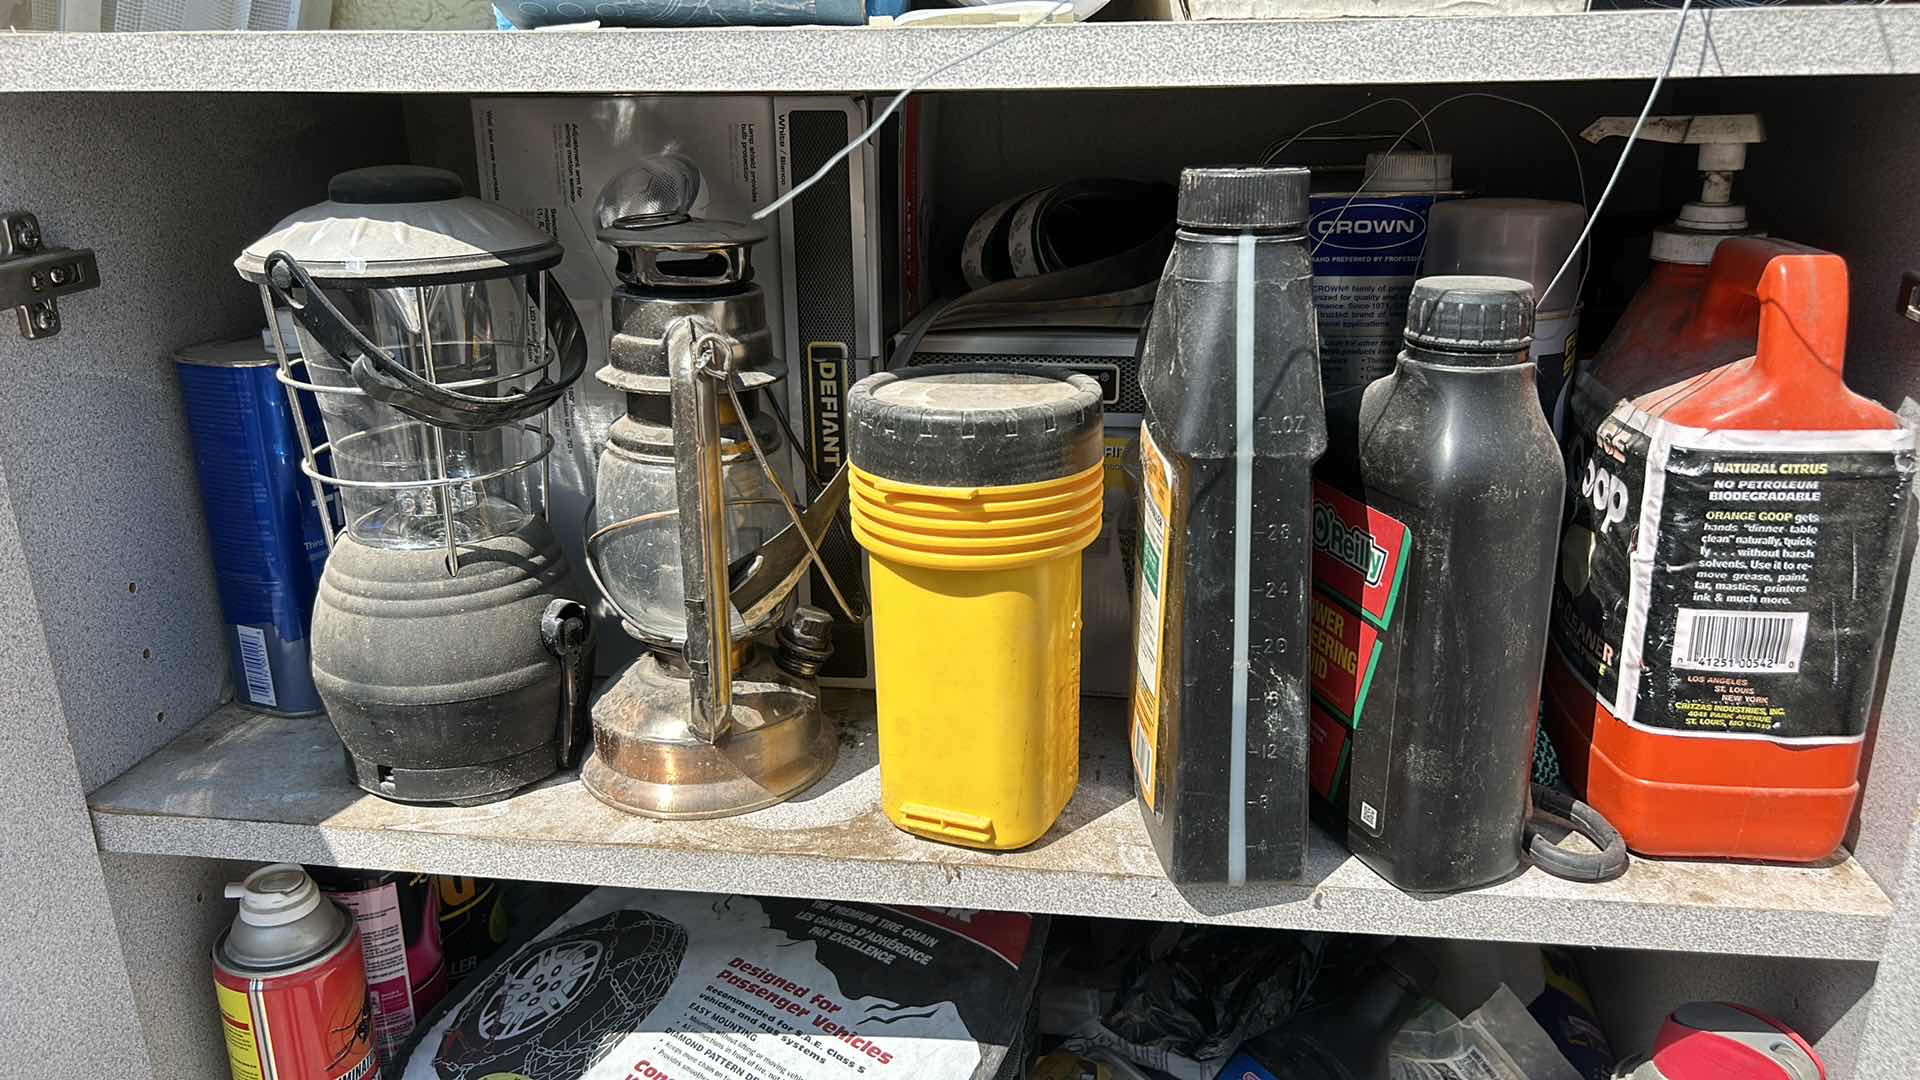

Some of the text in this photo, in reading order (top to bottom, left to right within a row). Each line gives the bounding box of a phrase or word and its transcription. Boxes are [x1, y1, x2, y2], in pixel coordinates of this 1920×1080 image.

[778, 114, 786, 147] White
[1318, 219, 1414, 234] CROWN
[819, 361, 841, 466] DEFIANT
[1712, 462, 1829, 474] NATURAL CITRUS
[1713, 480, 1820, 490] NO PETROLEUM
[1708, 491, 1821, 501] BIODEGRADABLE
[1705, 511, 1820, 524] ORANGE GOOP gets
[1703, 522, 1739, 532] hands
[1789, 524, 1819, 534] table
[1735, 535, 1783, 547] naturally,
[1783, 536, 1817, 547] quick-
[1738, 547, 1780, 558] without
[1782, 548, 1815, 559] harsh
[1698, 559, 1813, 571] solvents. Use it to re-
[1732, 573, 1773, 582] grease,
[1265, 580, 1289, 600] 24
[1693, 581, 1807, 594] tar, mastics, printers
[1692, 592, 1792, 605] ink & much more.
[1263, 637, 1288, 654] 20
[1698, 658, 1733, 668] 41251
[1739, 659, 1773, 668] 00542
[1687, 675, 1748, 686] LOS ANGELES
[1728, 686, 1755, 695] LOUIS
[1721, 694, 1769, 704] NEW YORK
[1674, 702, 1713, 711] CRITZAS
[1713, 703, 1767, 715] INDUSTRIES,
[1709, 711, 1735, 720] PARK
[1735, 713, 1773, 724] AVENUE
[1261, 743, 1279, 759] 12
[795, 911, 817, 921] LES
[878, 918, 905, 934] TIRE
[901, 928, 940, 948] CHAIN
[808, 926, 897, 965] PAR EXCELLENCE
[728, 957, 812, 999] Designed
[687, 1001, 758, 1043] EASY MOUNTING
[706, 984, 777, 1023] Recommended
[776, 1018, 795, 1033] for
[794, 1030, 824, 1051] S.A.E.
[716, 970, 894, 1065] Passenger Vehicles
[699, 992, 827, 1065] vehicles and ABS systems
[664, 1026, 746, 1078] DIAMOND PATTERN
[732, 1050, 748, 1063] front
[697, 1060, 715, 1073] chain
[763, 1056, 787, 1075] moving
